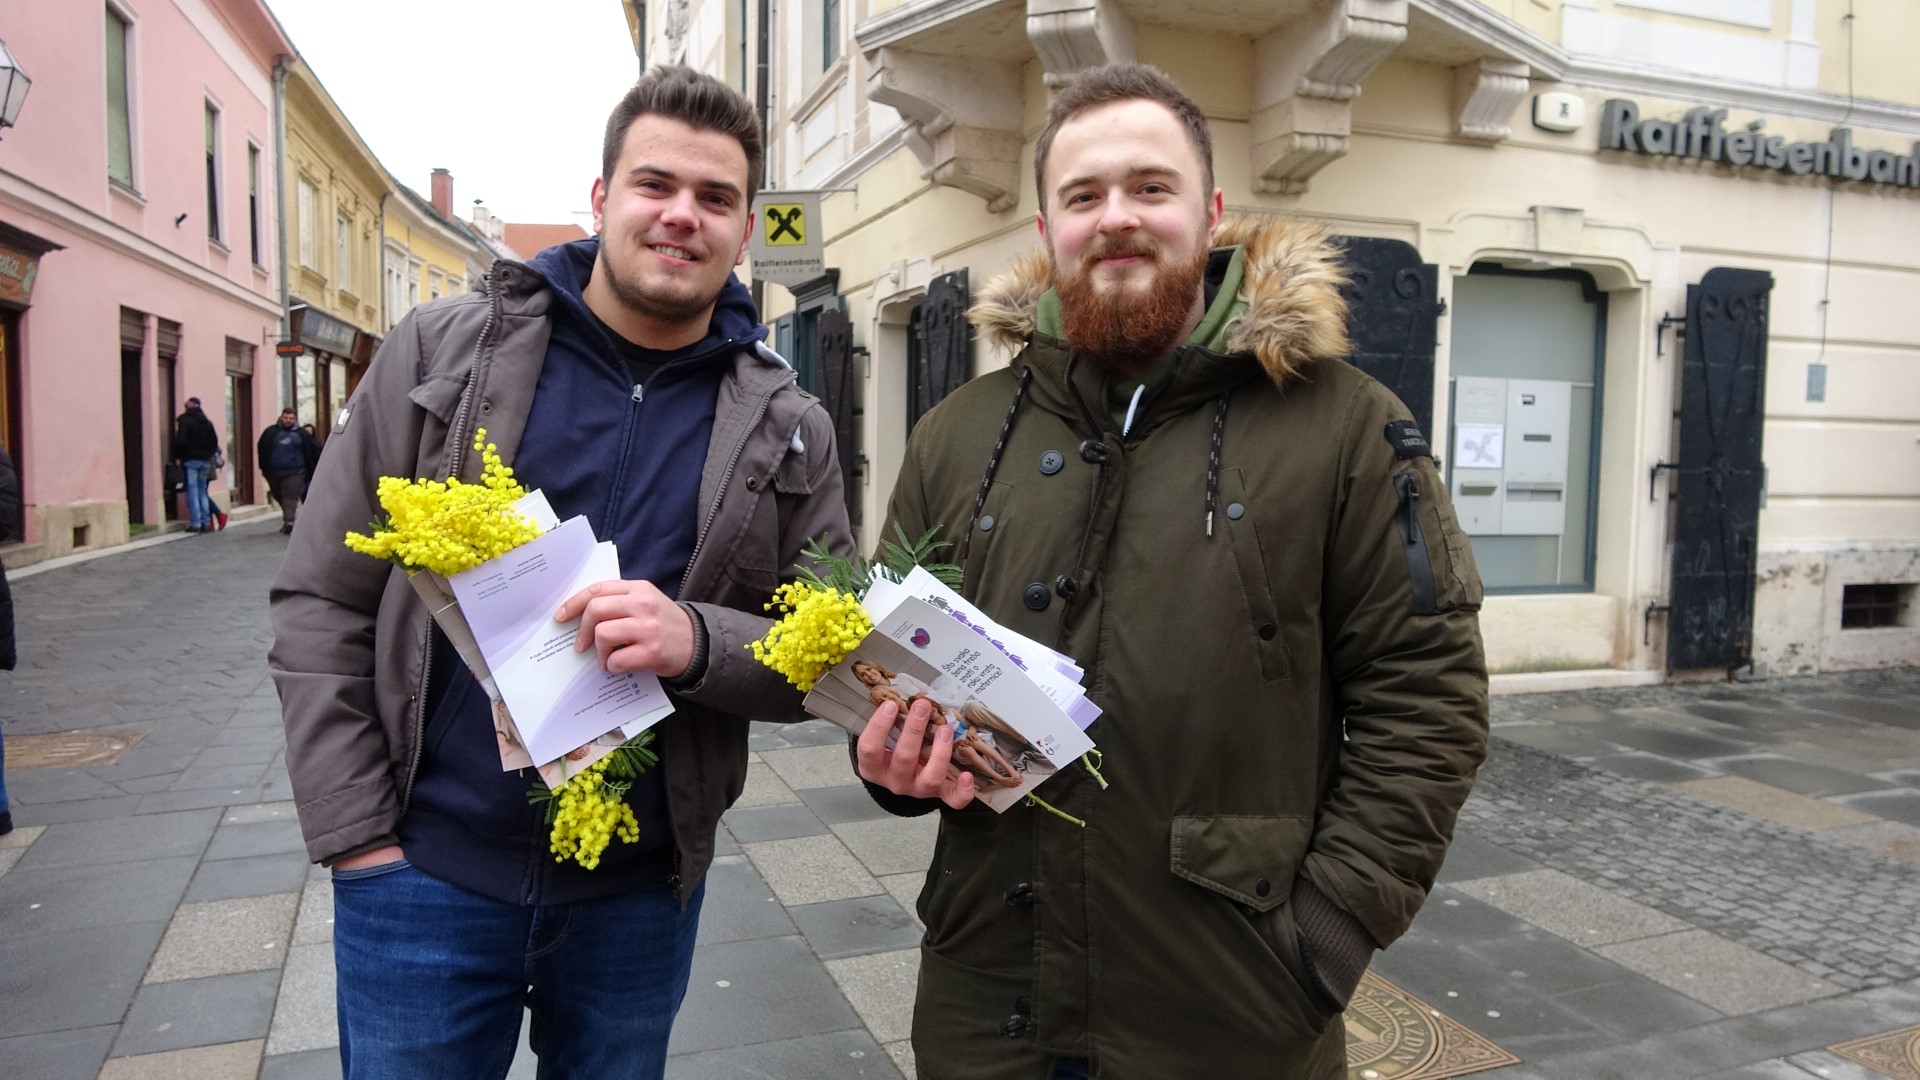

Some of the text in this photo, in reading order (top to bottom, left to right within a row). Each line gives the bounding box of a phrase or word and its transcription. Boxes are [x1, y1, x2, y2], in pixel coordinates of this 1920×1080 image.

[1602, 99, 1920, 188] Raiffeisenban
[754, 258, 821, 268] Raiffeisenbank
[953, 648, 970, 663] svaka
[962, 651, 981, 665] treba
[959, 668, 975, 683] znati
[967, 663, 996, 689] raku vrata
[974, 666, 1003, 695] maternice?
